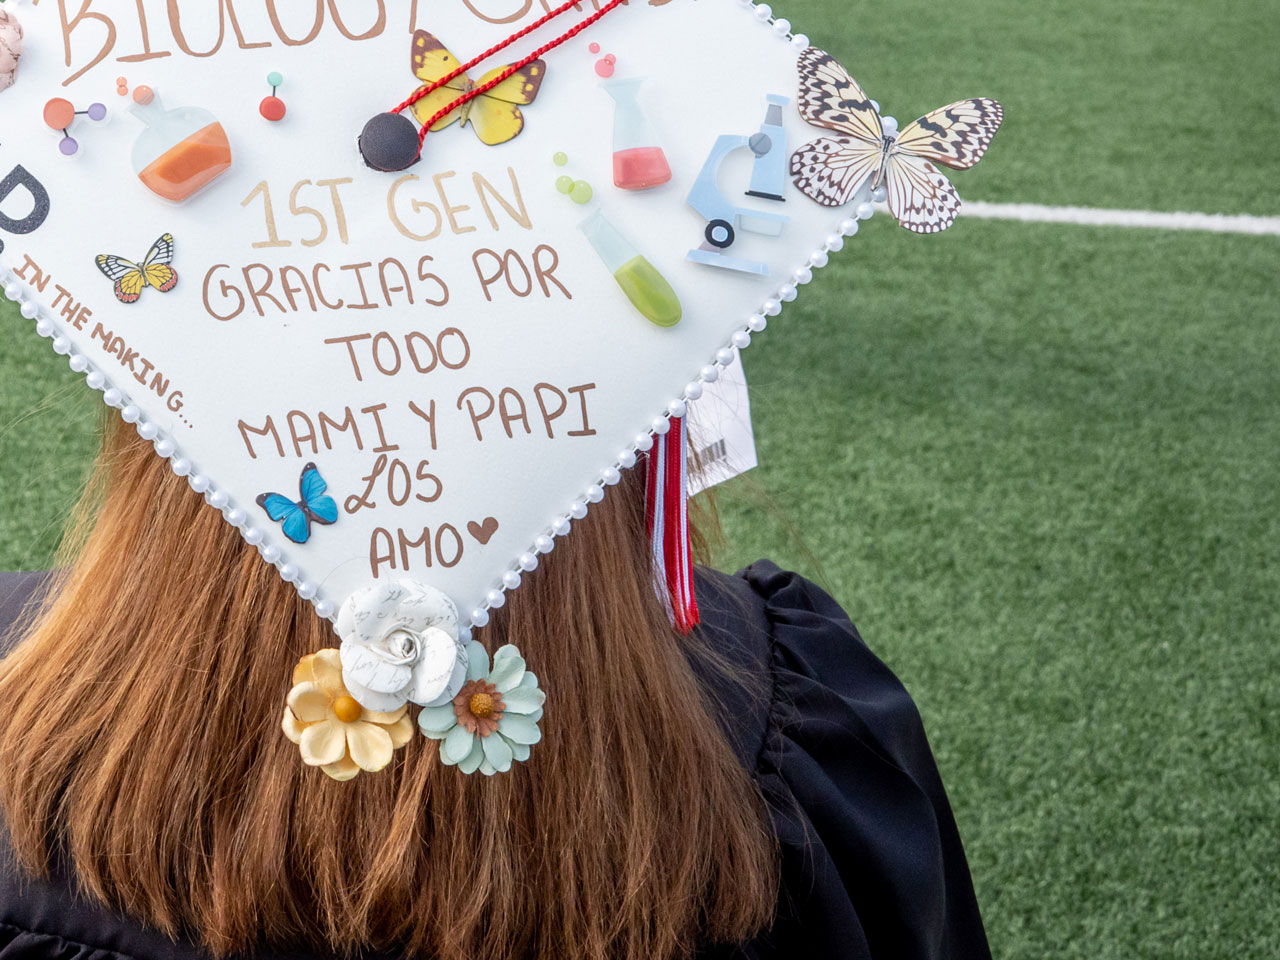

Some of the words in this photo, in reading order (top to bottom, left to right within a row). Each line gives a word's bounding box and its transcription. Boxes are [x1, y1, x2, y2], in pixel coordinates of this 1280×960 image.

[240, 176, 354, 249] 1ST
[386, 166, 534, 242] GEN
[12, 253, 50, 294] IN
[49, 285, 93, 332] THE
[202, 255, 450, 321] GRACIAS
[471, 244, 573, 302] POR
[323, 326, 471, 382] TODO
[237, 402, 400, 459] MAMI
[408, 399, 438, 451] Y
[456, 382, 597, 441] PAPI
[343, 453, 443, 515] LOS
[369, 522, 464, 579] AMO
